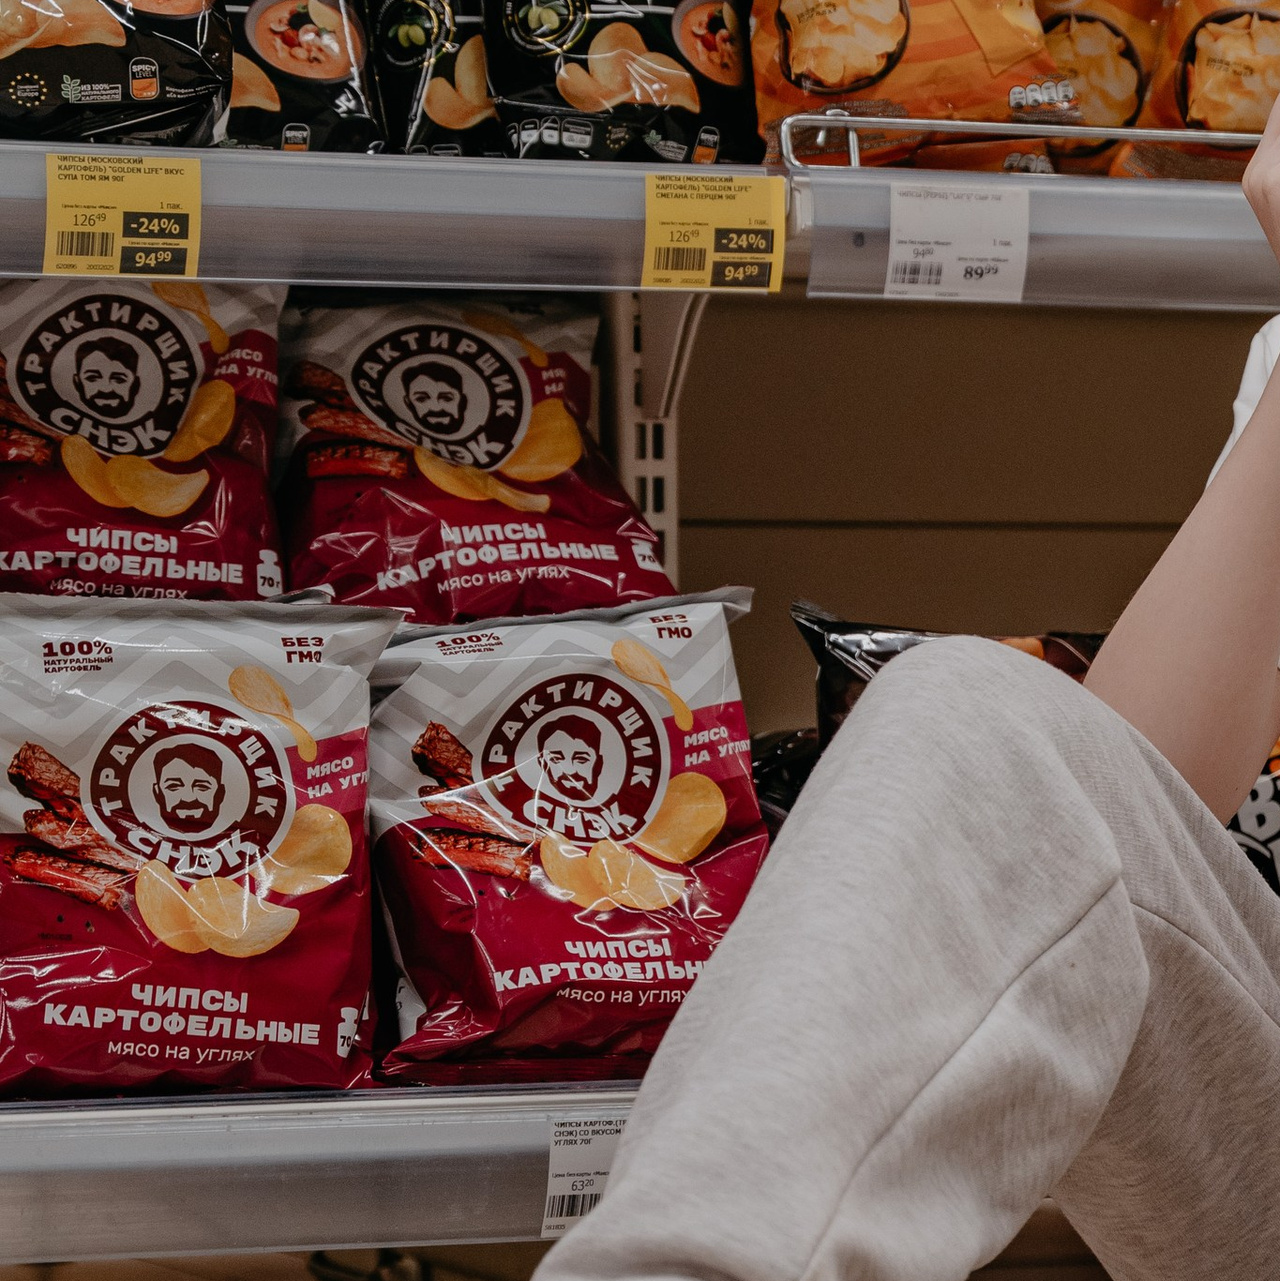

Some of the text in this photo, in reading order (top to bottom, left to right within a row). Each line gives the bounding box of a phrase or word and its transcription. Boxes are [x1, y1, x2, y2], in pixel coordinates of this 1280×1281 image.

[132, 64, 156, 72] SPICY
[57, 164, 107, 174] КАРТОФЕЛЬ)
[164, 168, 185, 176] ВКУС
[87, 157, 144, 165] (МОСКОВСКИЙ
[655, 183, 700, 192] КАРТОФЕЛЬ)
[166, 202, 183, 210] пак.
[130, 217, 180, 235] -24%
[721, 232, 767, 250] -24%
[135, 251, 172, 268] 9499
[724, 264, 759, 281] 9499
[24, 302, 190, 406] ТРАКТИРЩИК
[358, 330, 517, 418] ТРАКТИРЩИК
[50, 406, 171, 453] СНЭК
[394, 420, 505, 466] СНЭК
[66, 527, 178, 554] ЧИПСЫ
[440, 522, 547, 544] ЧИПСЫ
[376, 542, 619, 592] КАРТОФЕЛЬНЫЕ
[436, 565, 571, 595] мясо на углях
[281, 636, 325, 648] БЕЗ
[435, 632, 501, 649] 100%
[657, 626, 693, 640] ГМО
[42, 640, 113, 658] 100%
[286, 650, 324, 664] ГМО
[44, 655, 113, 666] НАТУРАЛЬНЫЙ
[44, 665, 102, 674] КАРТОФЕЛЬ
[488, 679, 653, 792] ТРАКТИРЩИК
[684, 726, 728, 748] МЯСО
[99, 707, 280, 819] ТРАКТИРЩИК
[307, 756, 354, 780] МЯСО
[684, 750, 710, 768] НА
[307, 780, 334, 800] НА
[521, 799, 639, 839] СНЭК
[127, 827, 261, 877] СНЭК
[565, 937, 672, 960] ЧИПСЫ
[494, 960, 708, 993] КАРТОФЕЛЬН
[131, 983, 249, 1013] ЧИПСЫ
[557, 987, 605, 1004] мясо
[610, 988, 634, 1003] на
[43, 1002, 321, 1045] КАРТОФЕЛЬНЫЕ
[107, 1040, 255, 1063] мясо на углях
[554, 1129, 578, 1137] СНЭК)
[591, 1128, 622, 1136] ВКУСОМ
[571, 1179, 595, 1192] 6320
